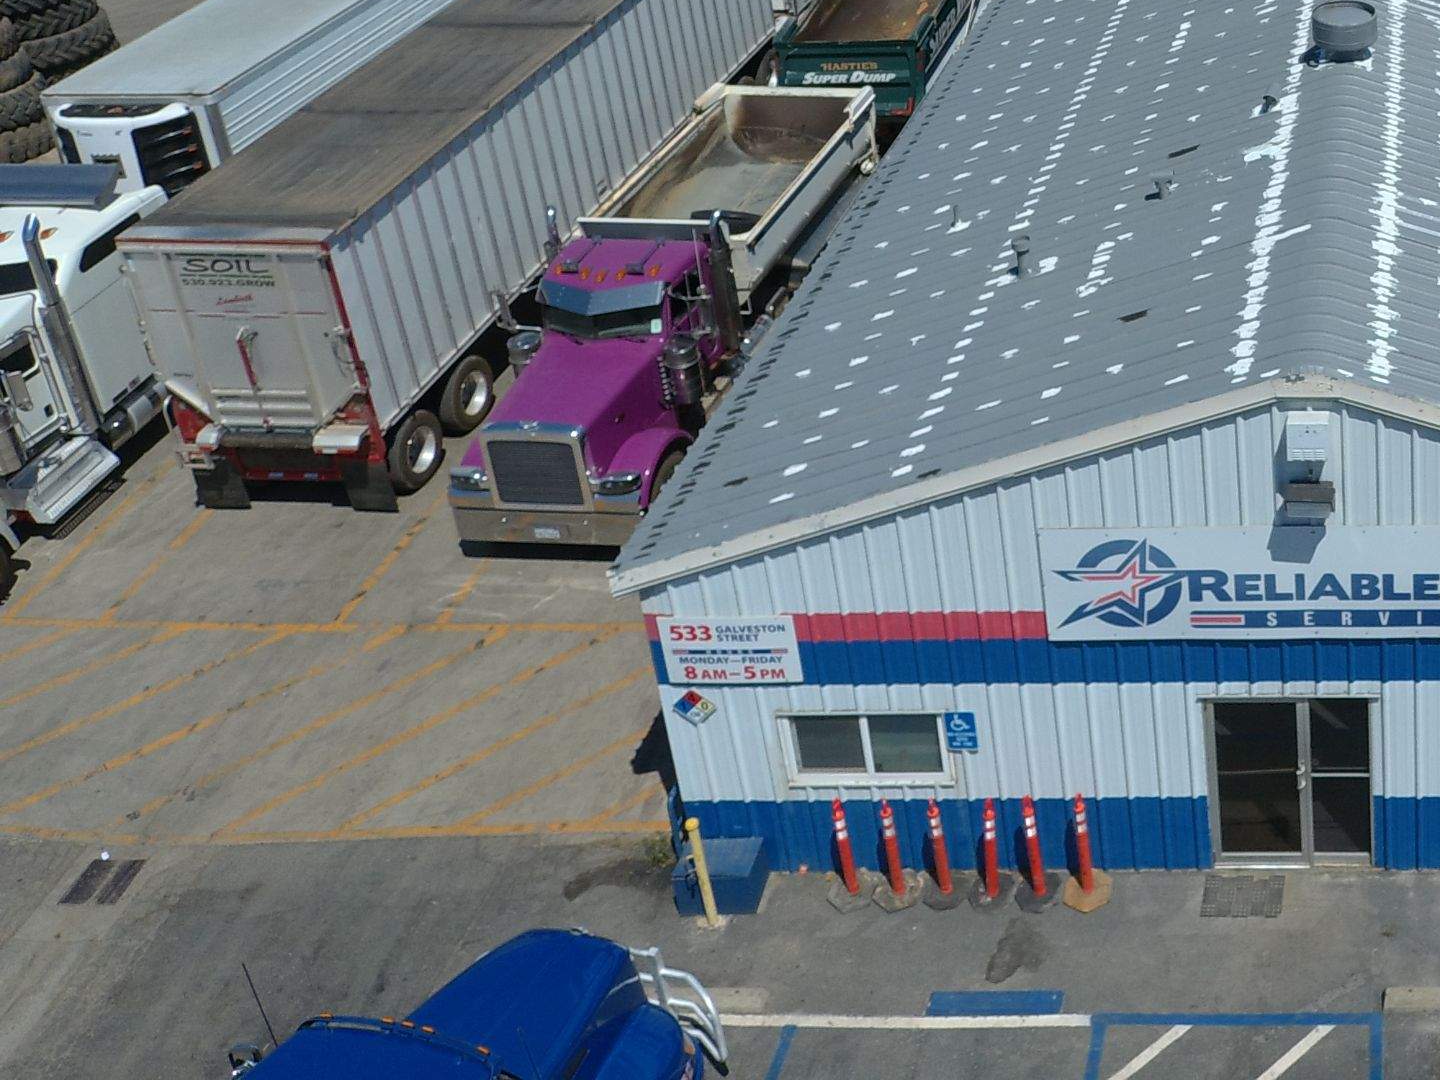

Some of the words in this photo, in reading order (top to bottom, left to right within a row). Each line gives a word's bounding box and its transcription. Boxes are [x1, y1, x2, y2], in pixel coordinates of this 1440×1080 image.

[802, 71, 848, 84] SUPER
[849, 70, 896, 83] DUMP
[182, 259, 269, 273] SOIL
[669, 625, 713, 641] 533
[715, 624, 786, 634] GALVESTON
[717, 634, 759, 642] STREET
[684, 666, 698, 680] 8
[760, 669, 786, 679] PM
